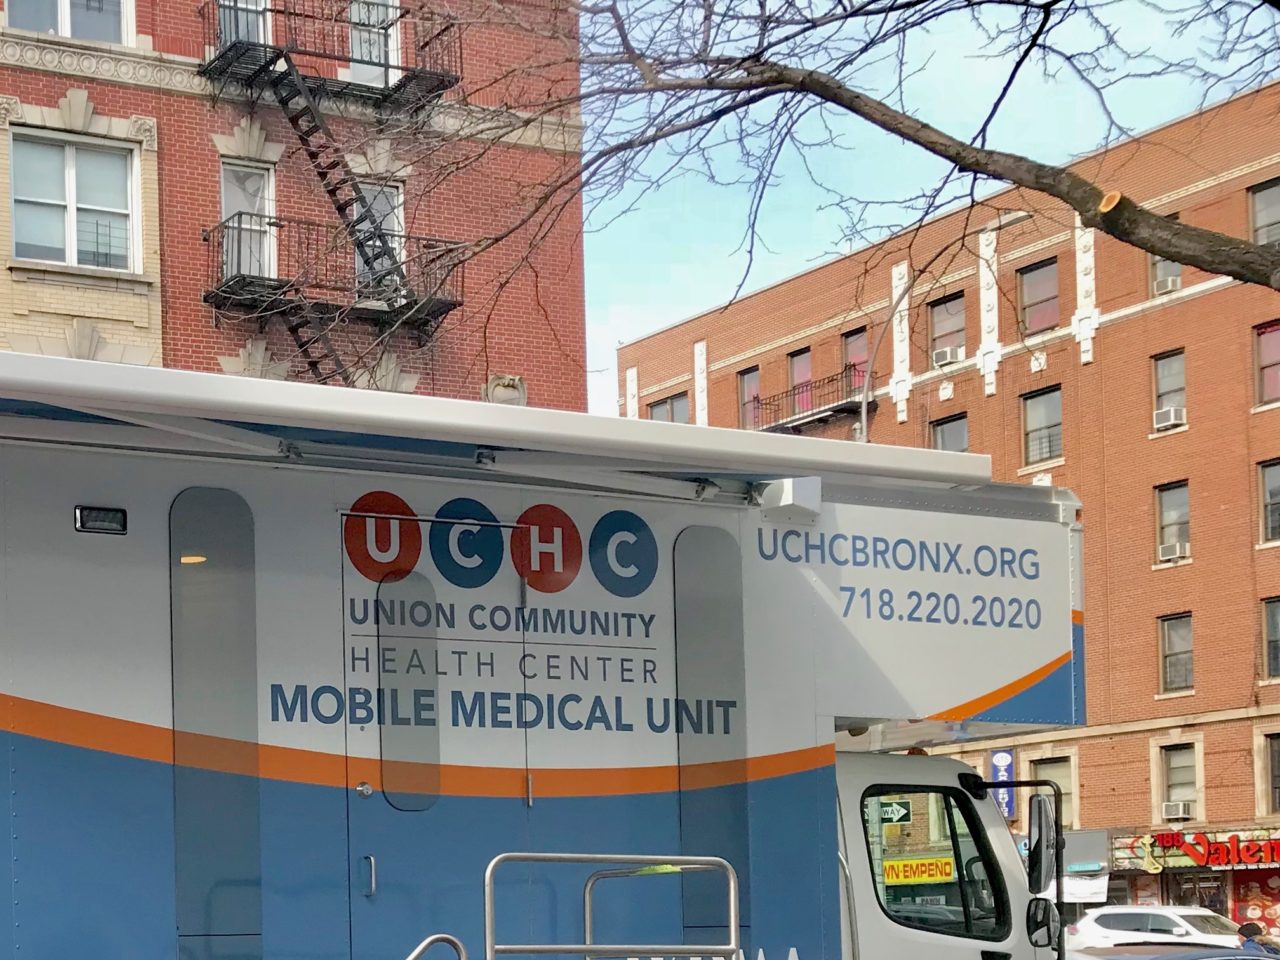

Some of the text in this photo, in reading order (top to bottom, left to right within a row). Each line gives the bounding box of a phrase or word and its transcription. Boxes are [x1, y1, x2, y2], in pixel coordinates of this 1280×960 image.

[757, 528, 1041, 580] UCHCBRONX.ORG
[349, 598, 657, 639] UNION COMMUNITY
[839, 585, 1042, 630] 718.220.2020
[351, 646, 659, 685] HEALTH CENTER
[270, 684, 738, 736] MOBILE MEDICAL UNIT
[882, 808, 901, 817] WAY
